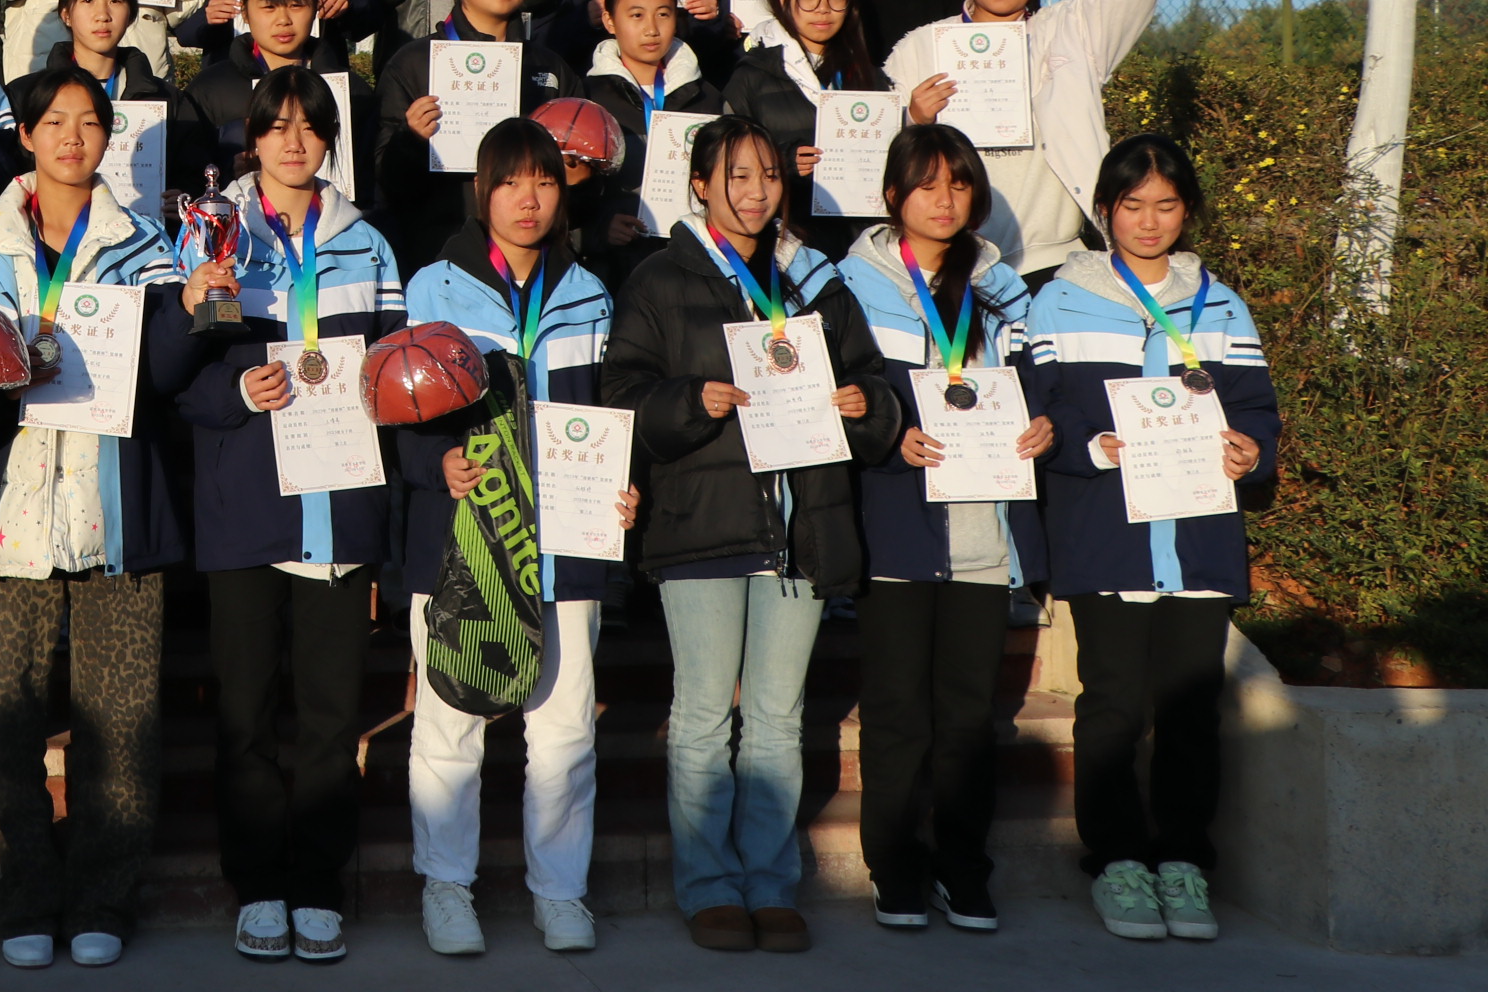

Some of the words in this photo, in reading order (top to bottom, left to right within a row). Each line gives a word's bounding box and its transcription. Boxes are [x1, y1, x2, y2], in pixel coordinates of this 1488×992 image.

[957, 59, 1006, 70] 获奖证书
[452, 80, 499, 92] 获奖证书
[836, 128, 881, 140] 获奖证书
[55, 322, 114, 339] 获奖证书
[292, 382, 347, 398] 获奖证书
[1142, 413, 1199, 429] 获奖证书
[547, 447, 604, 464] 获奖证书
